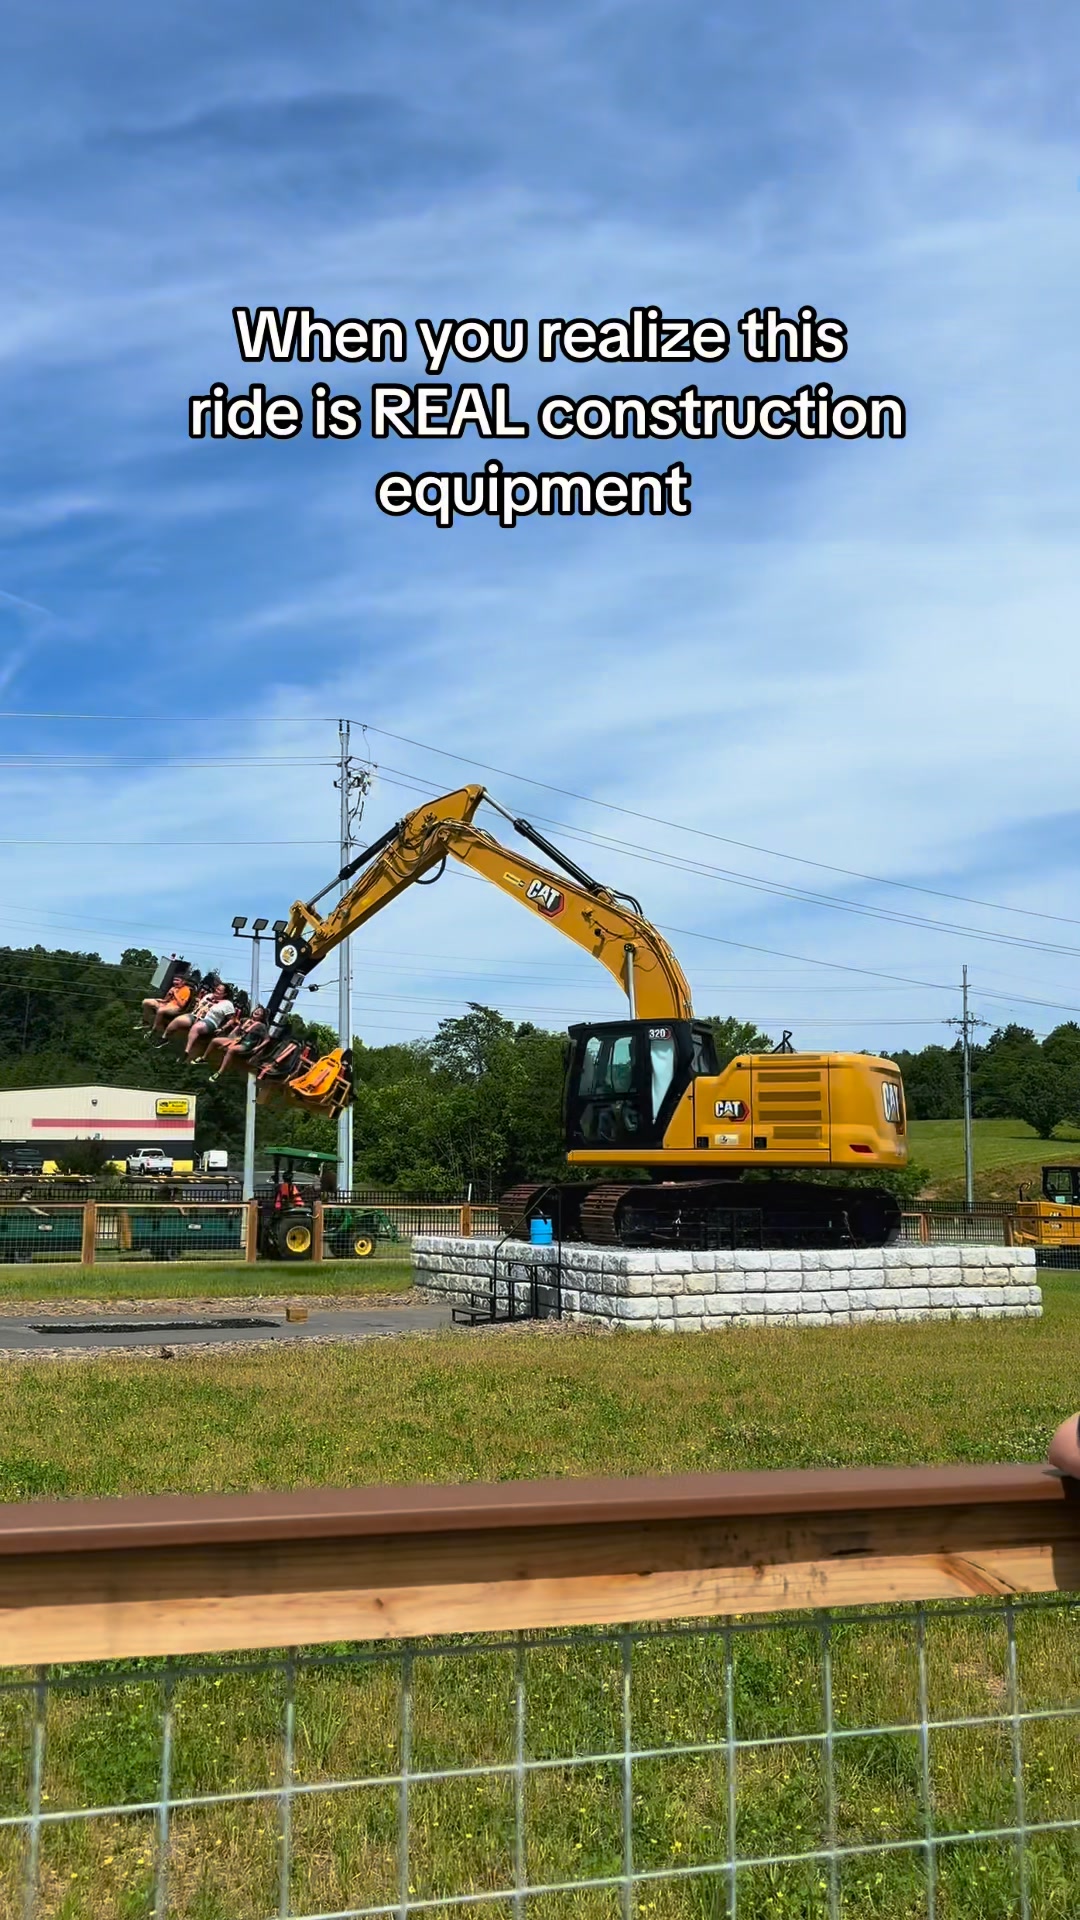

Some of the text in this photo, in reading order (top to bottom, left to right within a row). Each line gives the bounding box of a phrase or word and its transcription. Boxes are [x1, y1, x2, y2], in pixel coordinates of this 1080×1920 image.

[526, 879, 560, 909] CAT
[648, 1028, 666, 1038] 320
[715, 1100, 741, 1117] CAT
